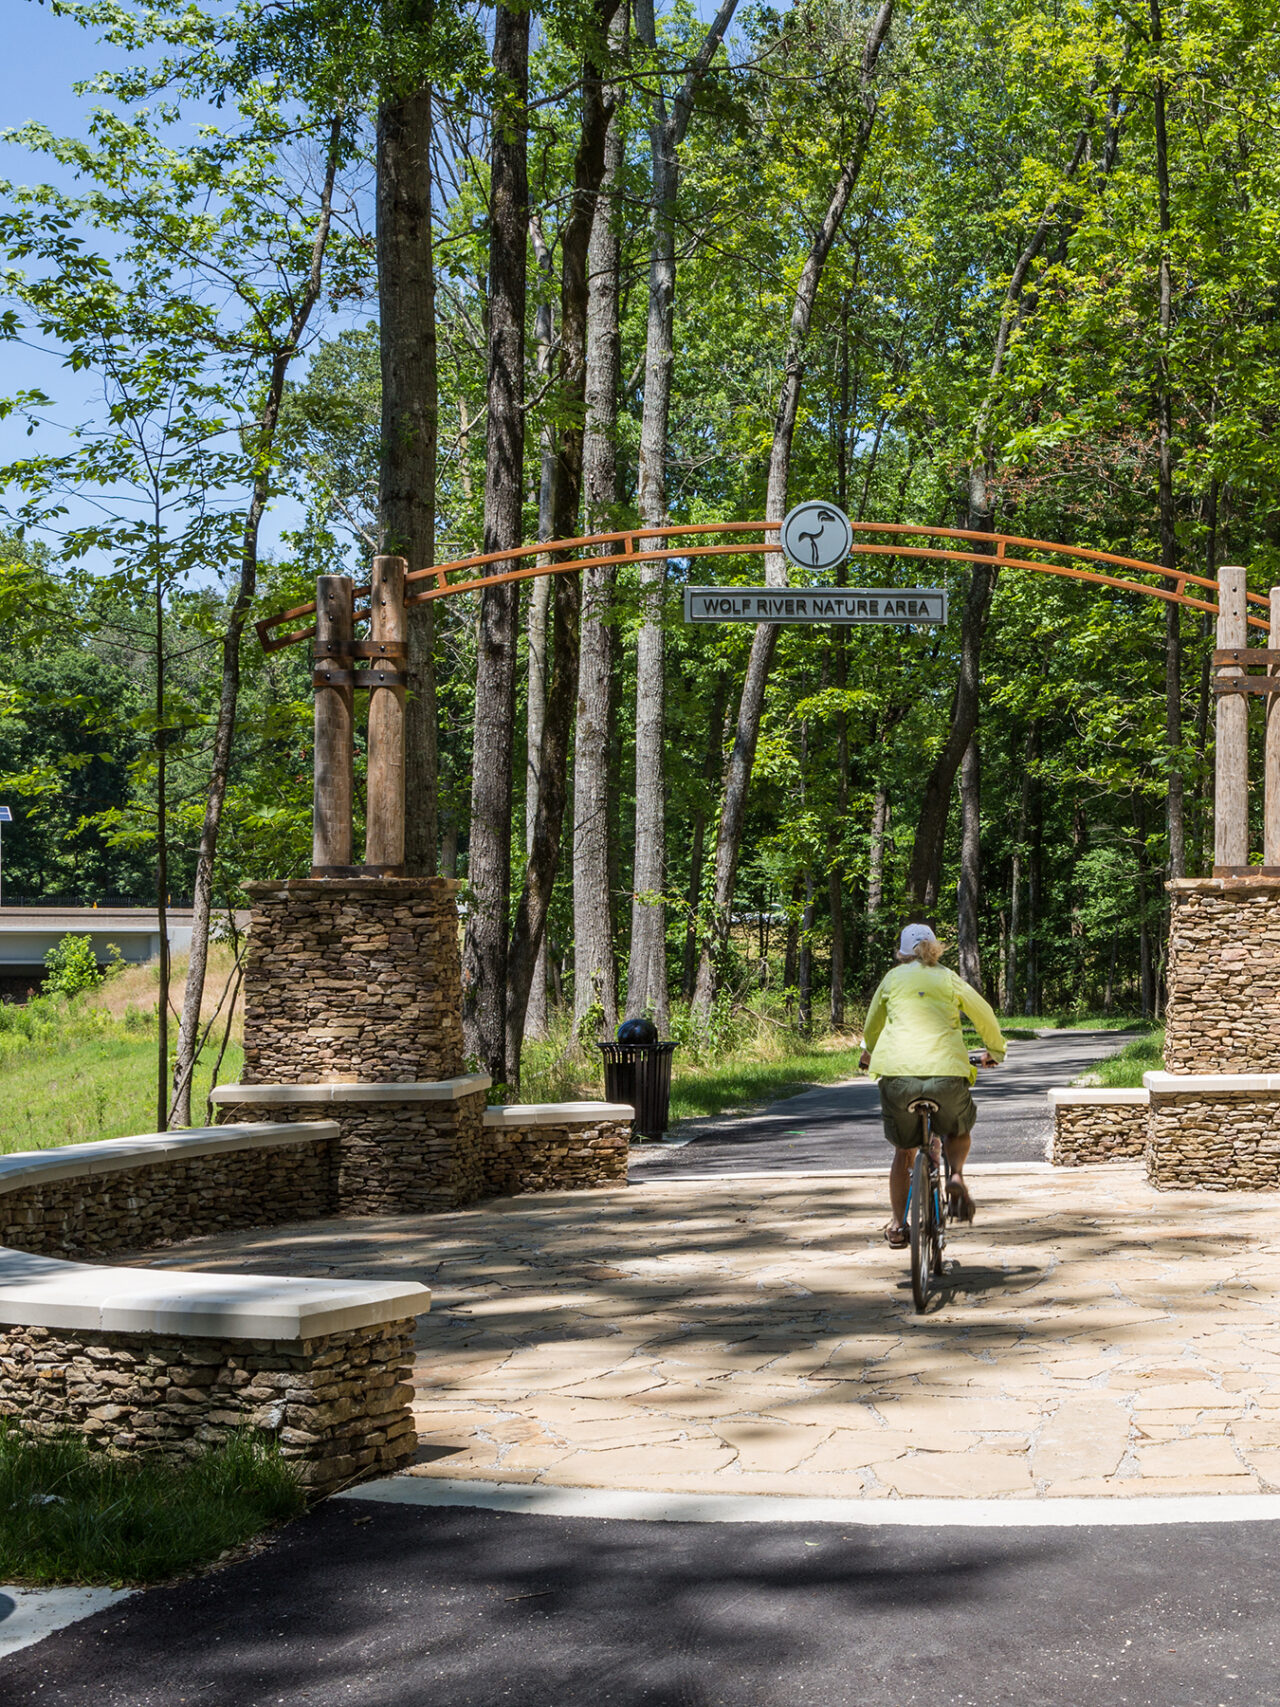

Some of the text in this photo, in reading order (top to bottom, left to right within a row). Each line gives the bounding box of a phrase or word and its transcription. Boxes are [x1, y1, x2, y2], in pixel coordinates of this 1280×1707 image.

[703, 599, 930, 617] WOLF RIVER NATURE AREA
